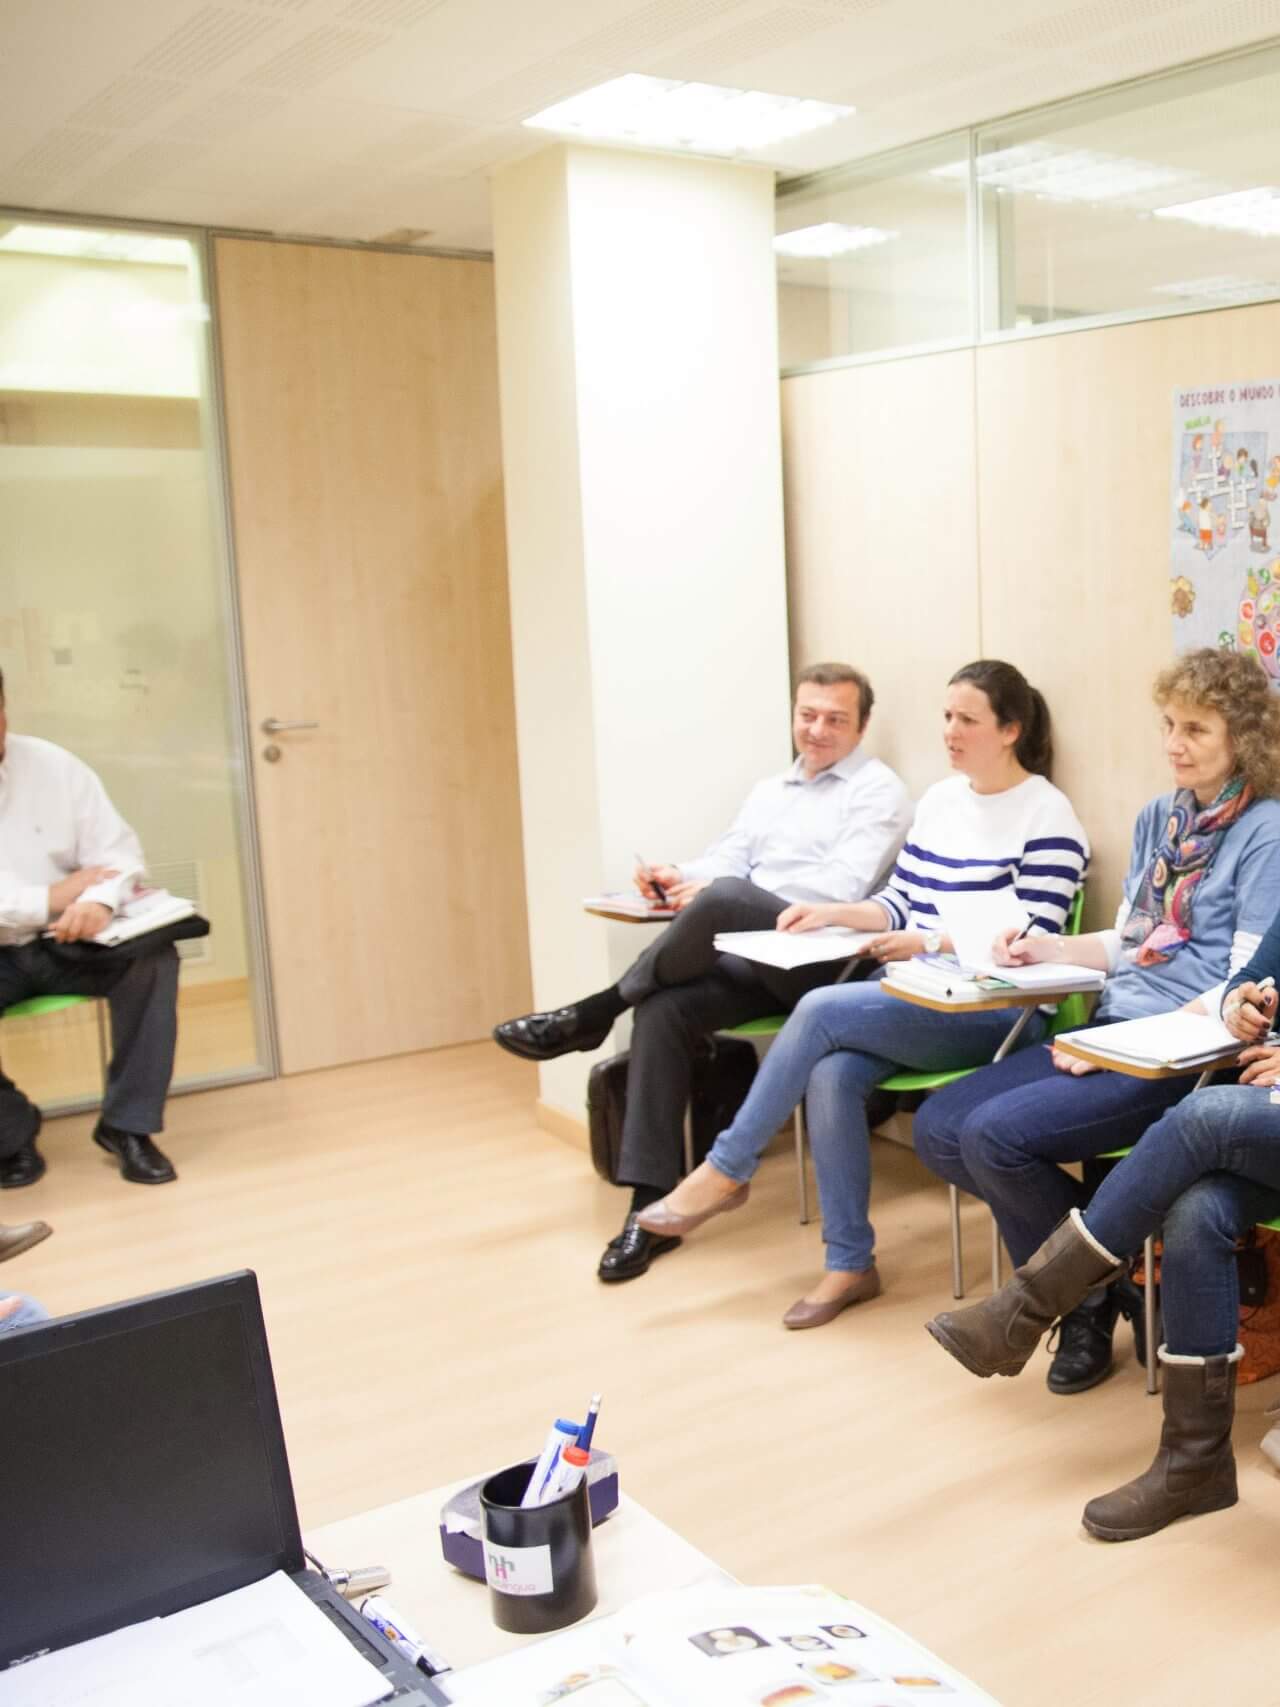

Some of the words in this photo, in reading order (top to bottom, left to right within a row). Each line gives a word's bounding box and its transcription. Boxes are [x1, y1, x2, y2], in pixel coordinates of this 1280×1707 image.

[1179, 389, 1226, 408] DESCOBRE
[1229, 389, 1236, 403] O
[1239, 384, 1275, 402] MUNDO
